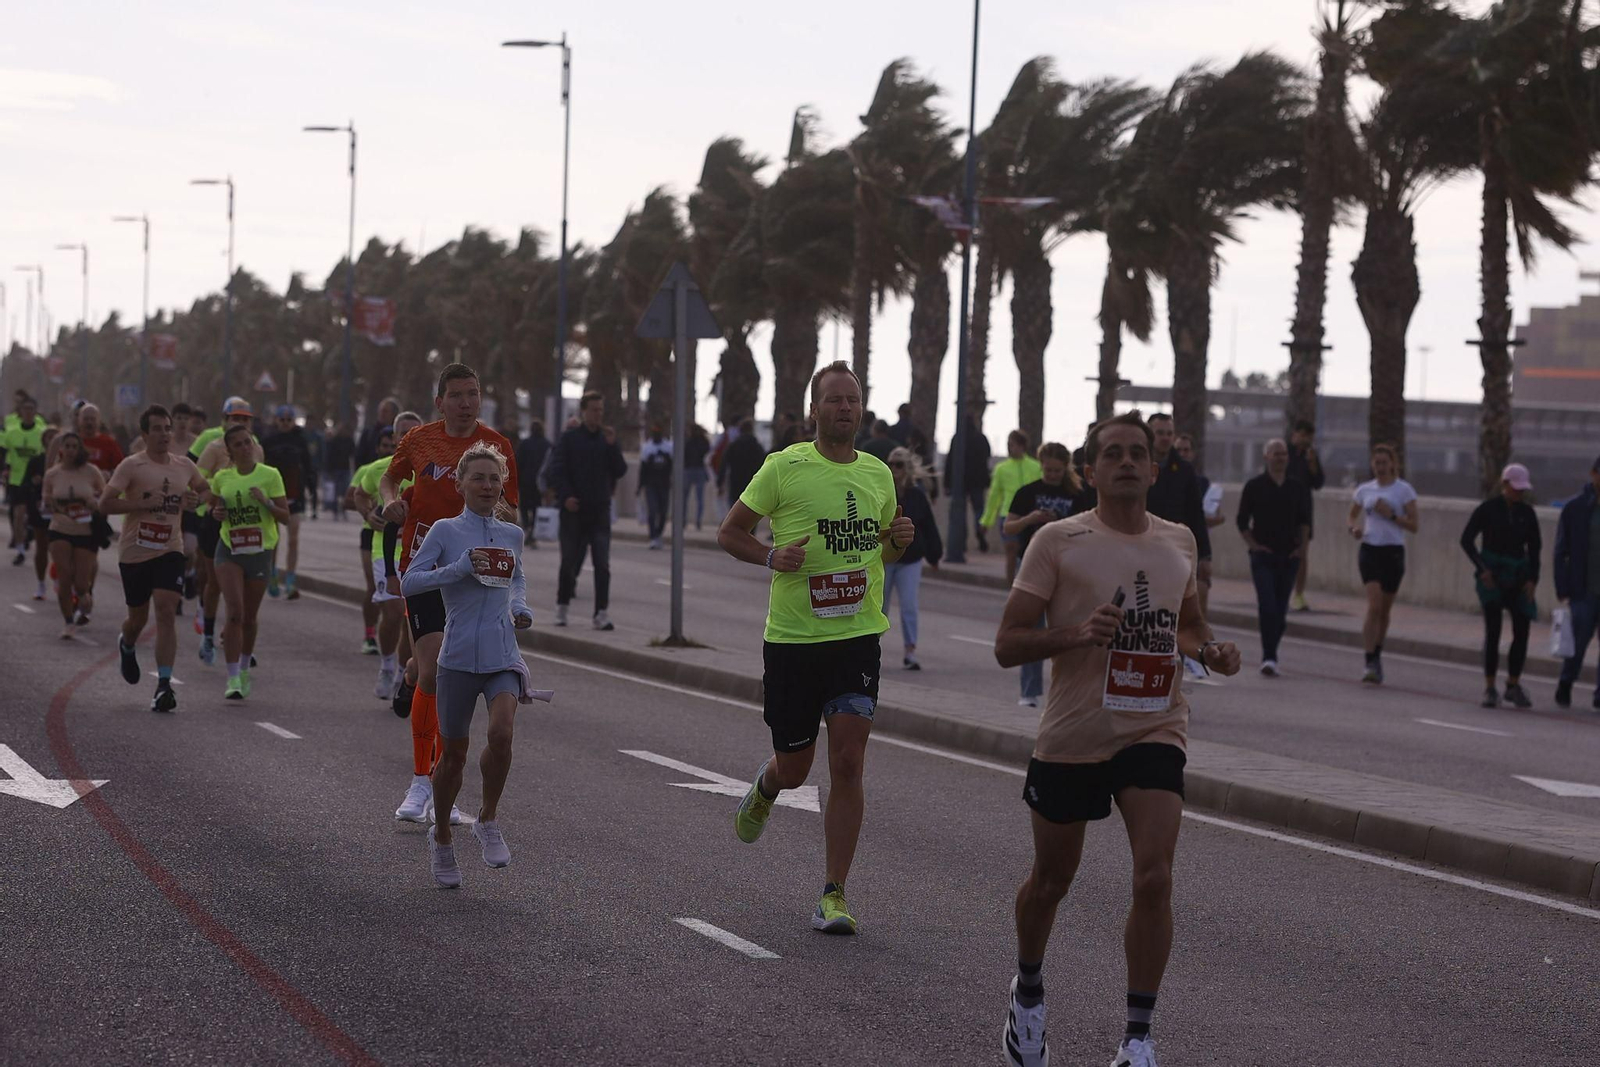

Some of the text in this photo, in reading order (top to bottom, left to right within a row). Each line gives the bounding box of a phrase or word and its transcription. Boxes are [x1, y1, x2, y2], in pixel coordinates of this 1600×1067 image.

[824, 533, 860, 554] RUN
[496, 561, 509, 571] 43
[839, 584, 865, 598] 1299
[1151, 674, 1166, 688] 31
